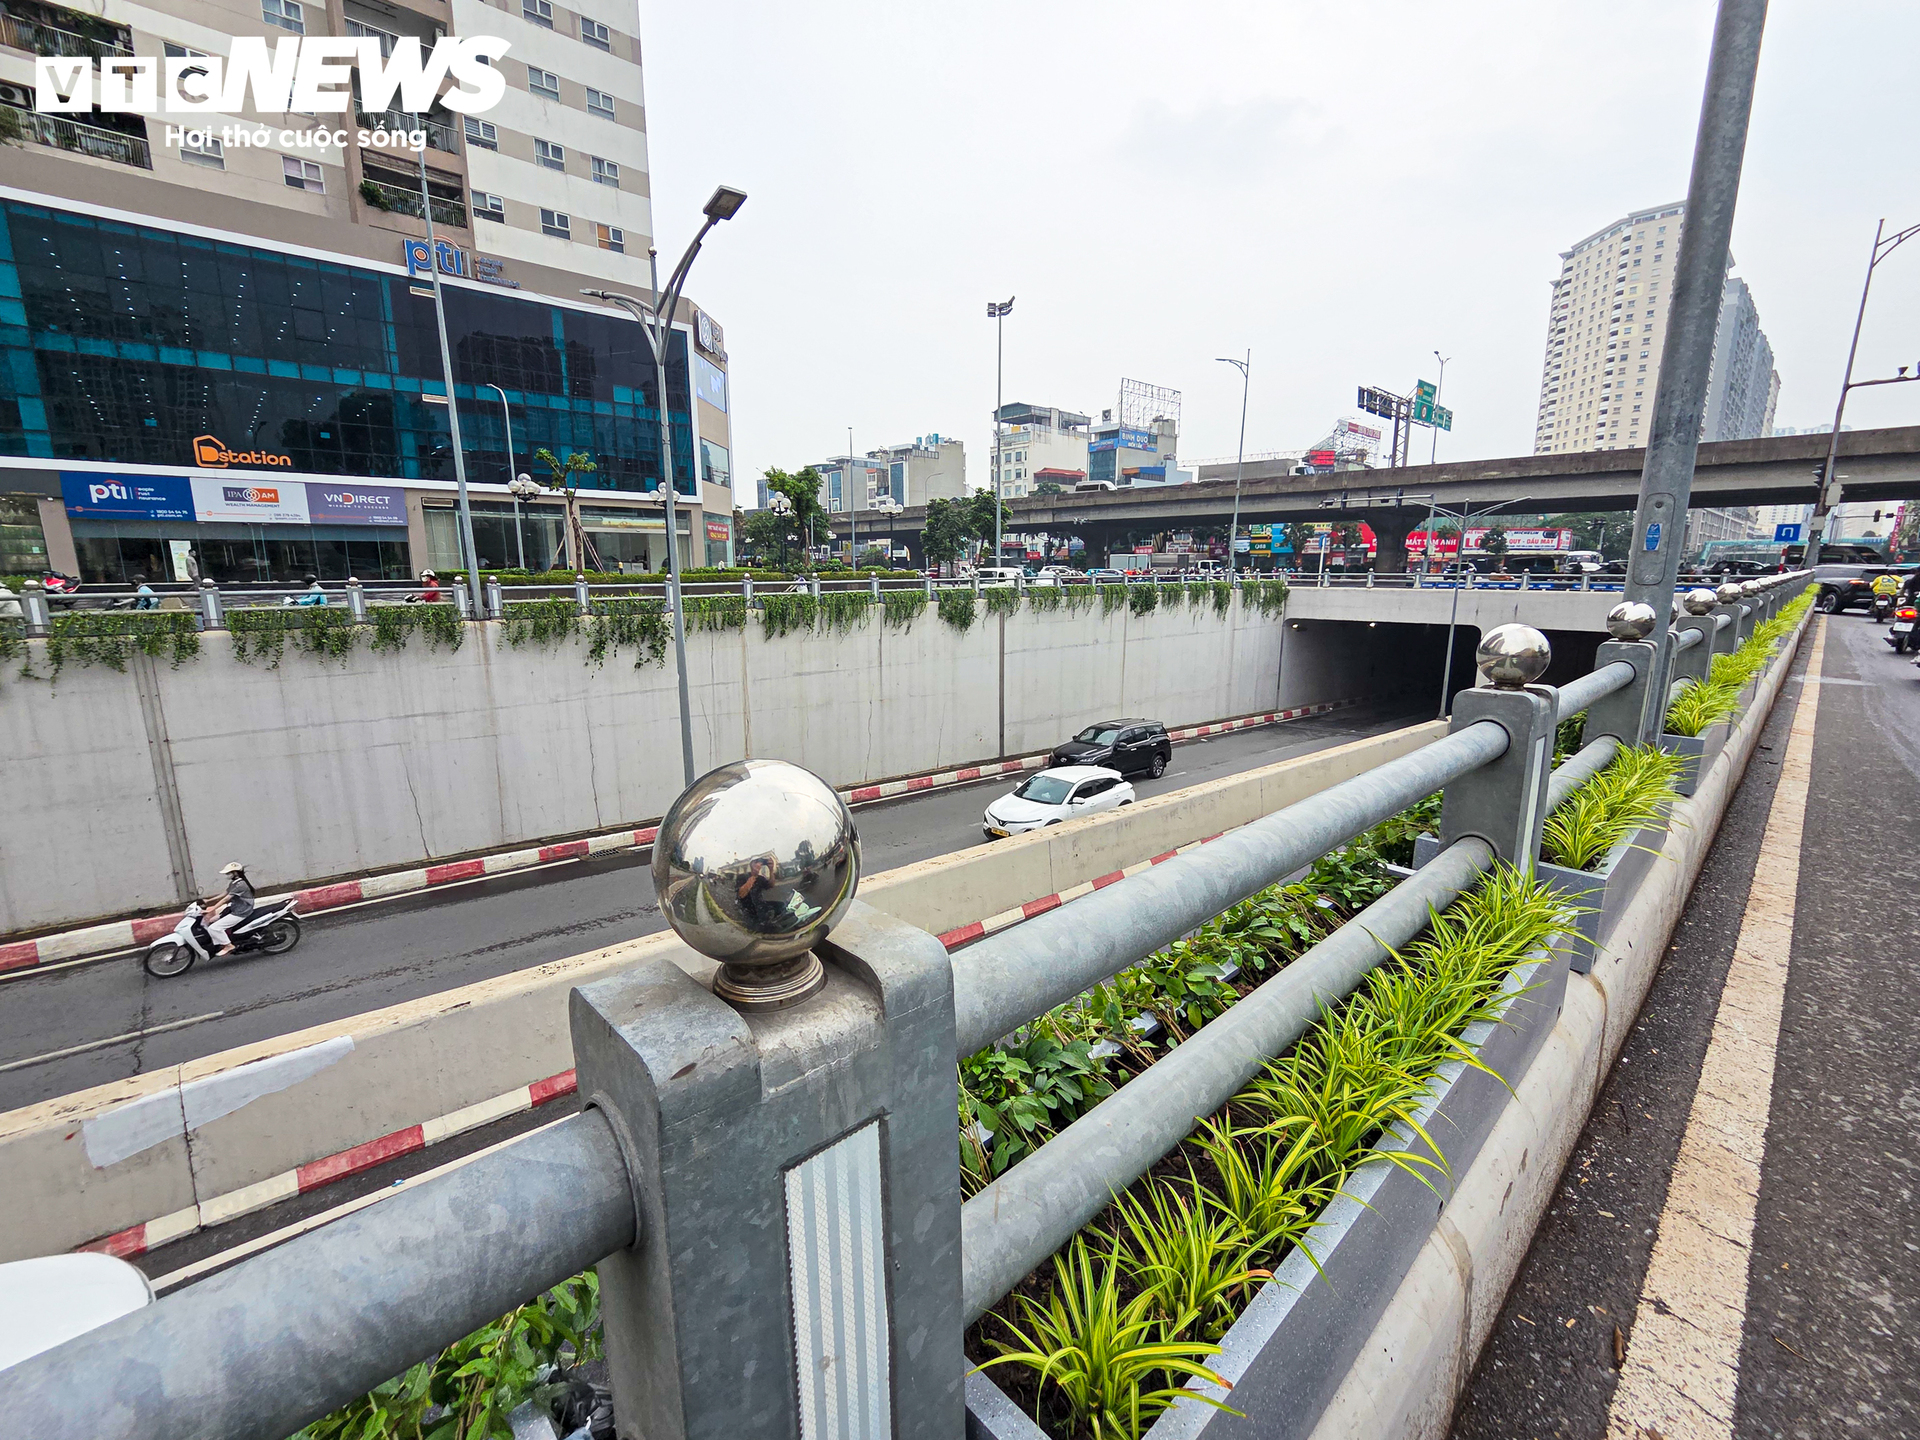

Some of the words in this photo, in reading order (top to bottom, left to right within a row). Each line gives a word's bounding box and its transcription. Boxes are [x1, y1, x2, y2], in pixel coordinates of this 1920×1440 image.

[88, 483, 128, 504] pti
[227, 490, 242, 498] IPA
[323, 492, 391, 505] VNDIRECT
[1440, 538, 1457, 546] ANH
